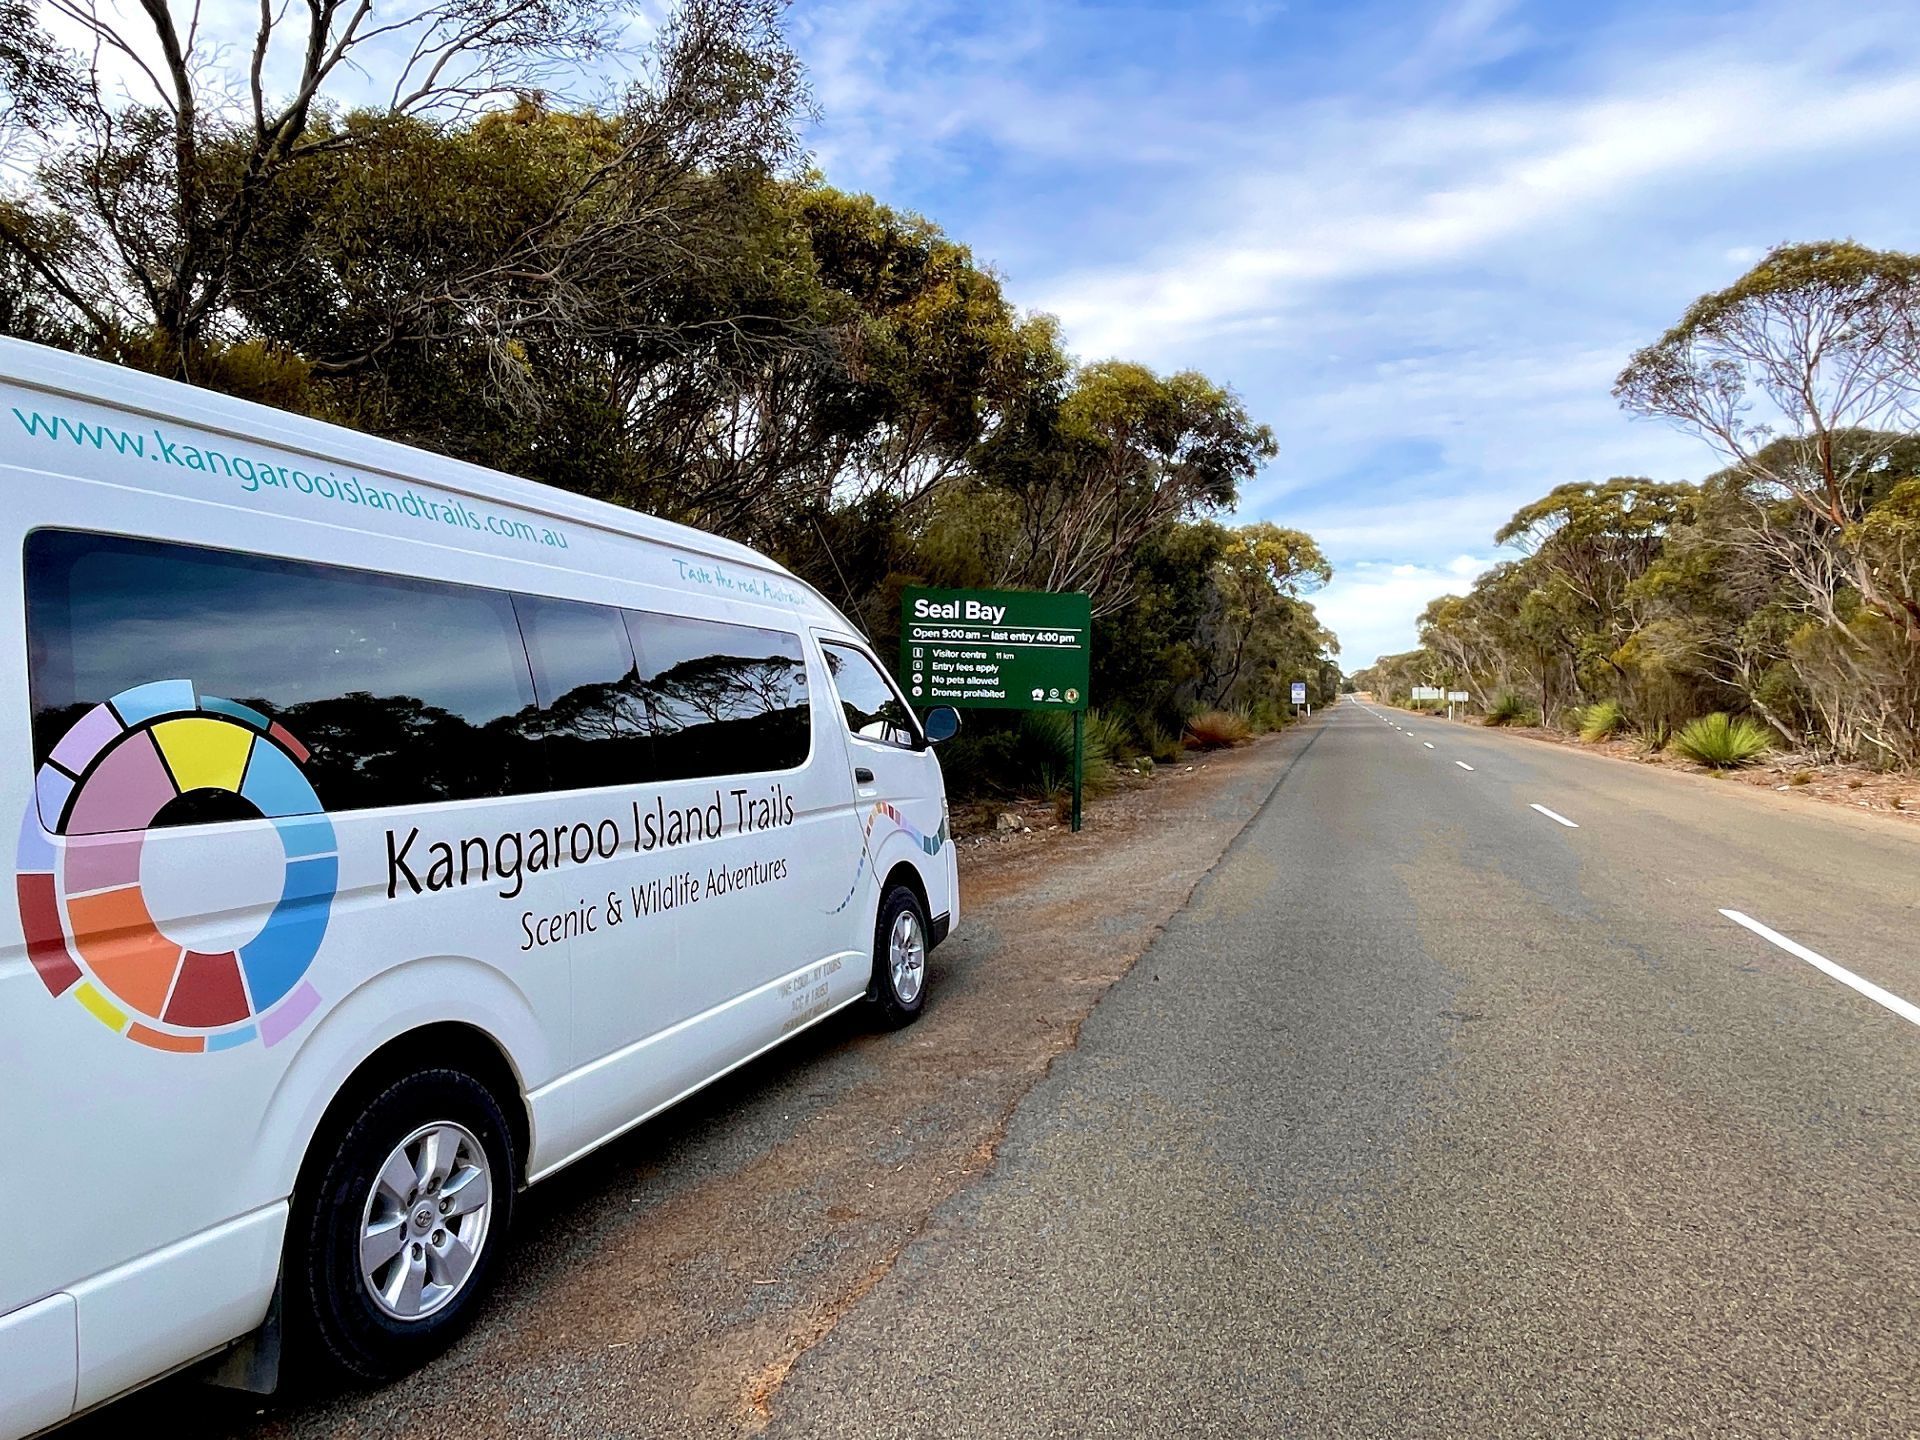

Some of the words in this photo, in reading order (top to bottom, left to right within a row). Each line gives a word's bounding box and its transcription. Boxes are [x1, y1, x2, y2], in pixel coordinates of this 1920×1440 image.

[11, 406, 569, 550] www.kangarooislandtrails.com.au
[671, 558, 713, 584] Taste
[714, 566, 734, 589] the
[737, 579, 760, 596] real
[914, 599, 960, 620] Seal
[965, 600, 1006, 625] Bay
[913, 628, 940, 639] Open
[942, 629, 964, 639] 9:00
[965, 631, 981, 640] am
[991, 630, 1009, 641] last
[1010, 632, 1036, 644] entry
[1036, 632, 1059, 642] 4:00
[1059, 634, 1076, 644] pm
[932, 649, 959, 659] Visitor
[960, 650, 987, 660] centre
[995, 652, 1003, 660] 11
[1003, 652, 1015, 660] km
[932, 662, 955, 673] Entry
[956, 662, 974, 671] fees
[975, 664, 999, 674] apply
[931, 675, 945, 684] No
[946, 676, 965, 685] pets
[966, 676, 999, 686] allowed
[931, 688, 962, 697] Drones
[963, 688, 1006, 699] prohibited
[385, 816, 620, 900] Kangaroo
[632, 790, 723, 853] Island
[730, 783, 795, 835] Trails
[520, 898, 598, 952] Scenic
[605, 891, 623, 927] &
[631, 871, 700, 919] Wildlife
[705, 857, 789, 900] Adventures
